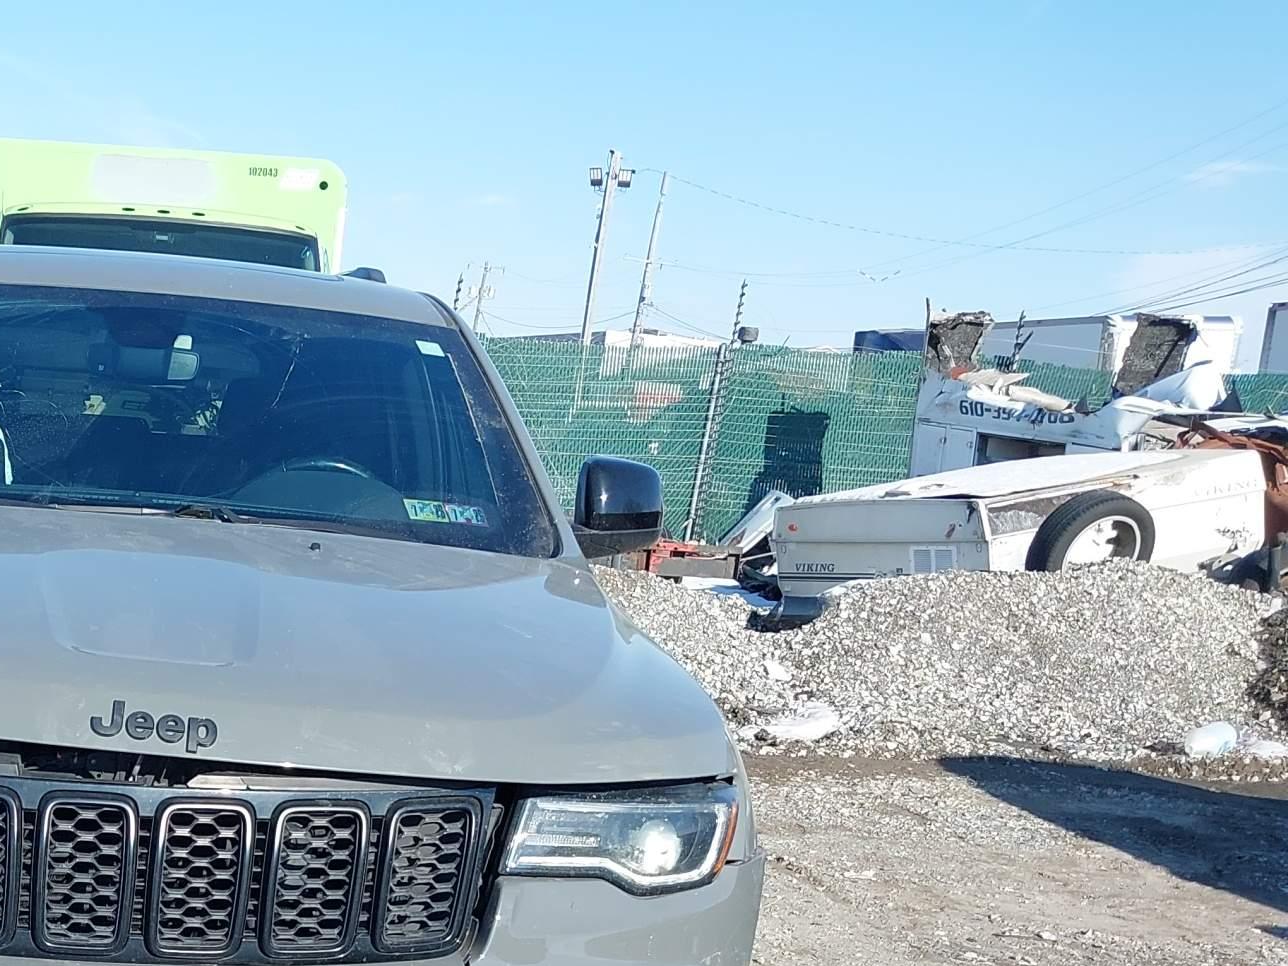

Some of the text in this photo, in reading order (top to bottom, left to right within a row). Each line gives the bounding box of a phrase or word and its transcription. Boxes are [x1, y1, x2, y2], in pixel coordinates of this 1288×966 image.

[248, 167, 279, 178] 102043
[795, 563, 835, 572] VIKING
[89, 699, 218, 754] Jeep
